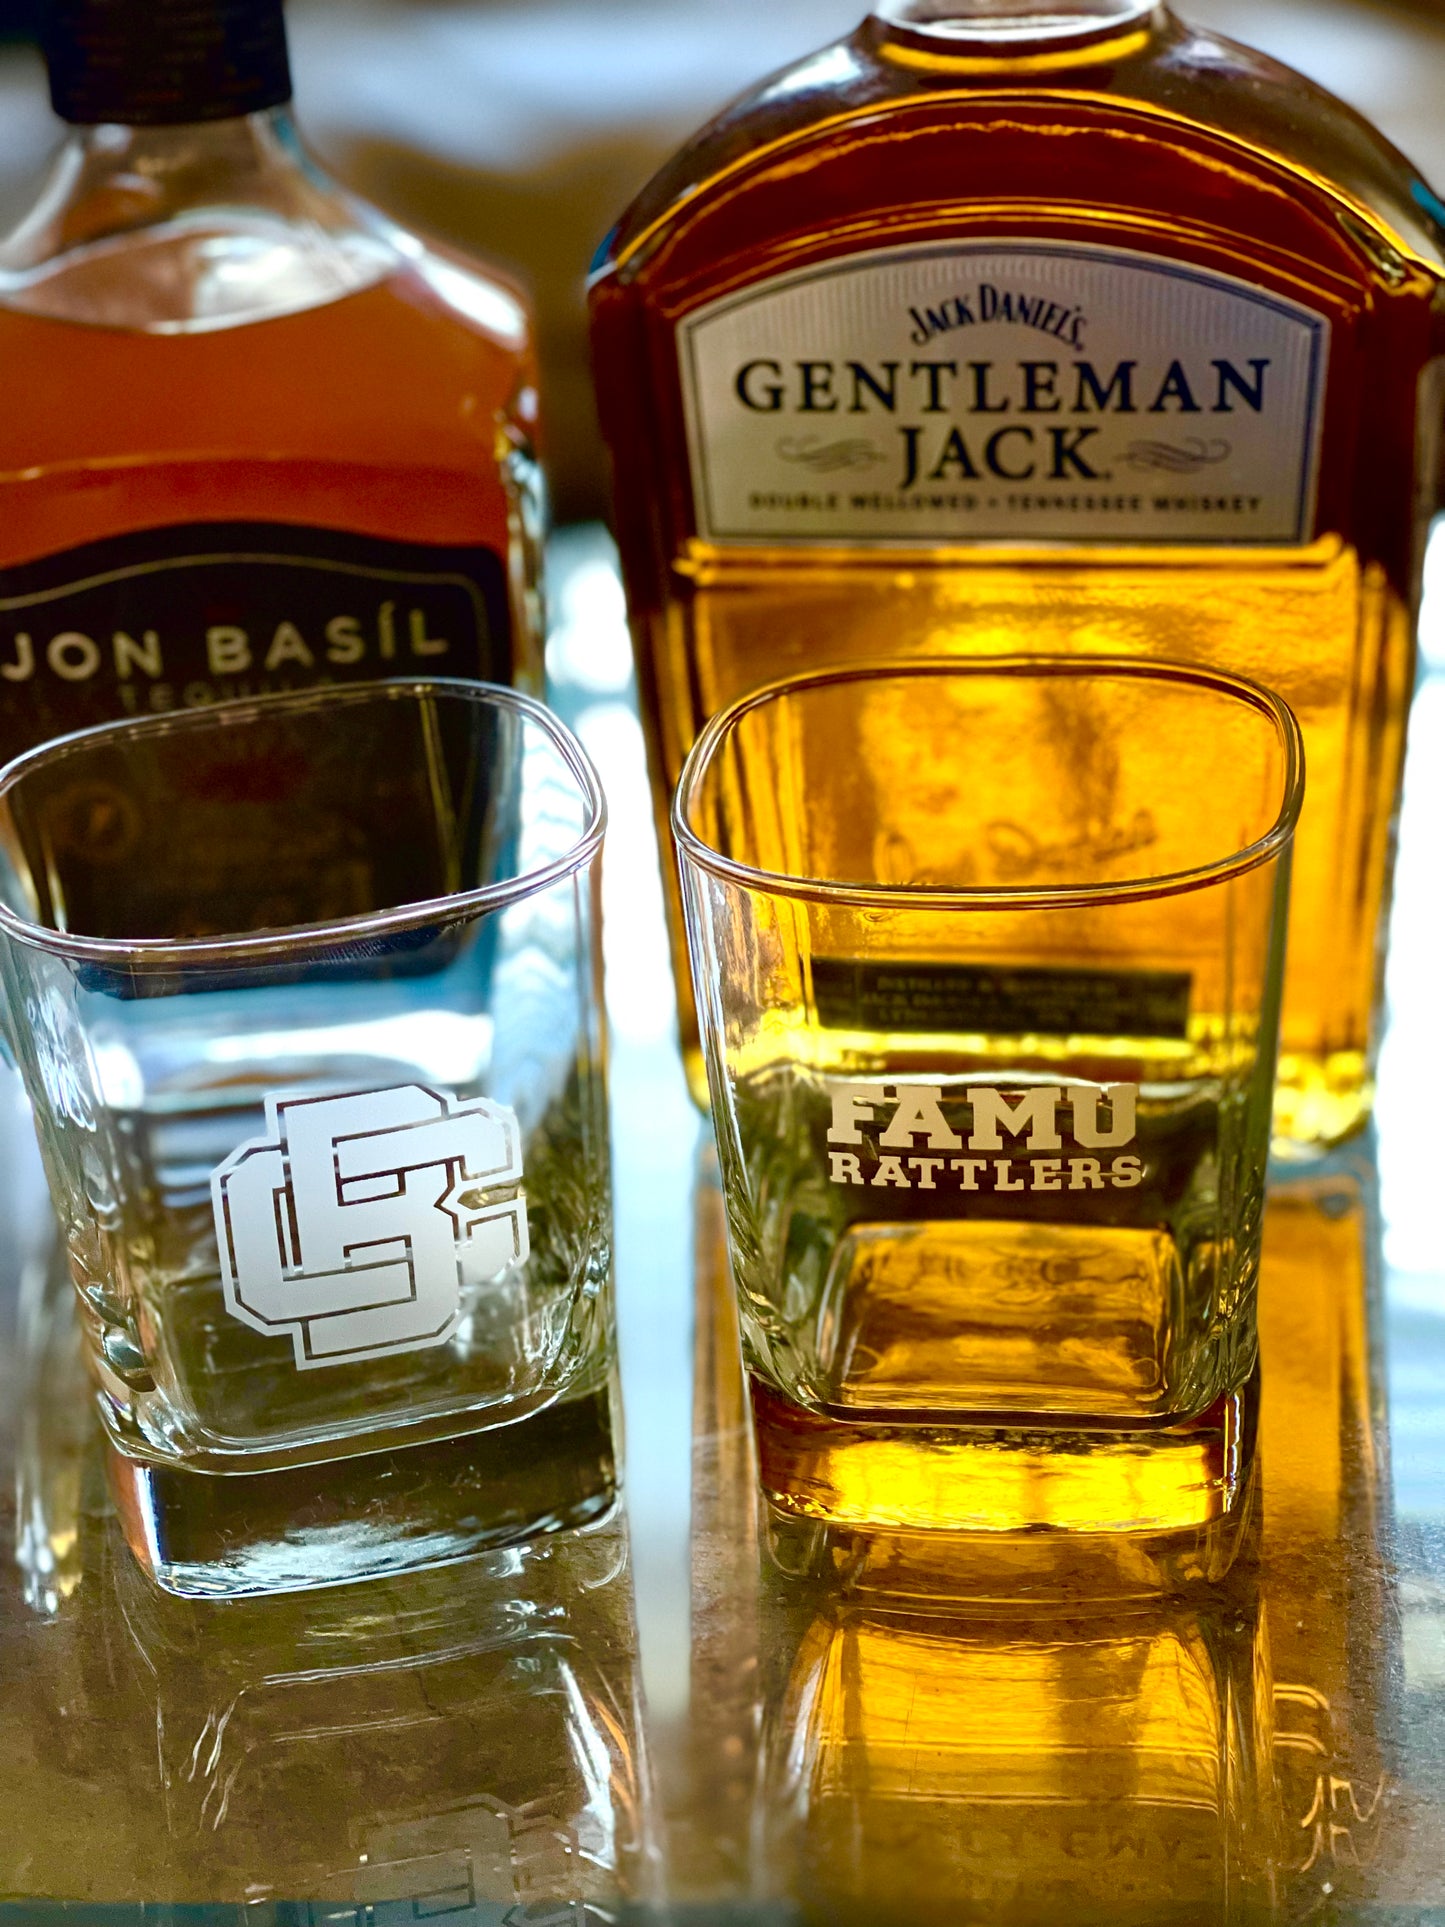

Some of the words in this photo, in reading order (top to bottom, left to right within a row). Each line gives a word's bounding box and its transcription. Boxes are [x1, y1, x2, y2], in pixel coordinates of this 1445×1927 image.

[908, 292, 976, 346] JACK
[734, 357, 1272, 415] GENTLEMAN
[899, 425, 1104, 490] JACK
[1006, 492, 1140, 512] TENNESSEE
[1, 630, 164, 682] JON
[827, 1083, 1140, 1151] FAMU
[827, 1150, 1143, 1192] RATTLERS
